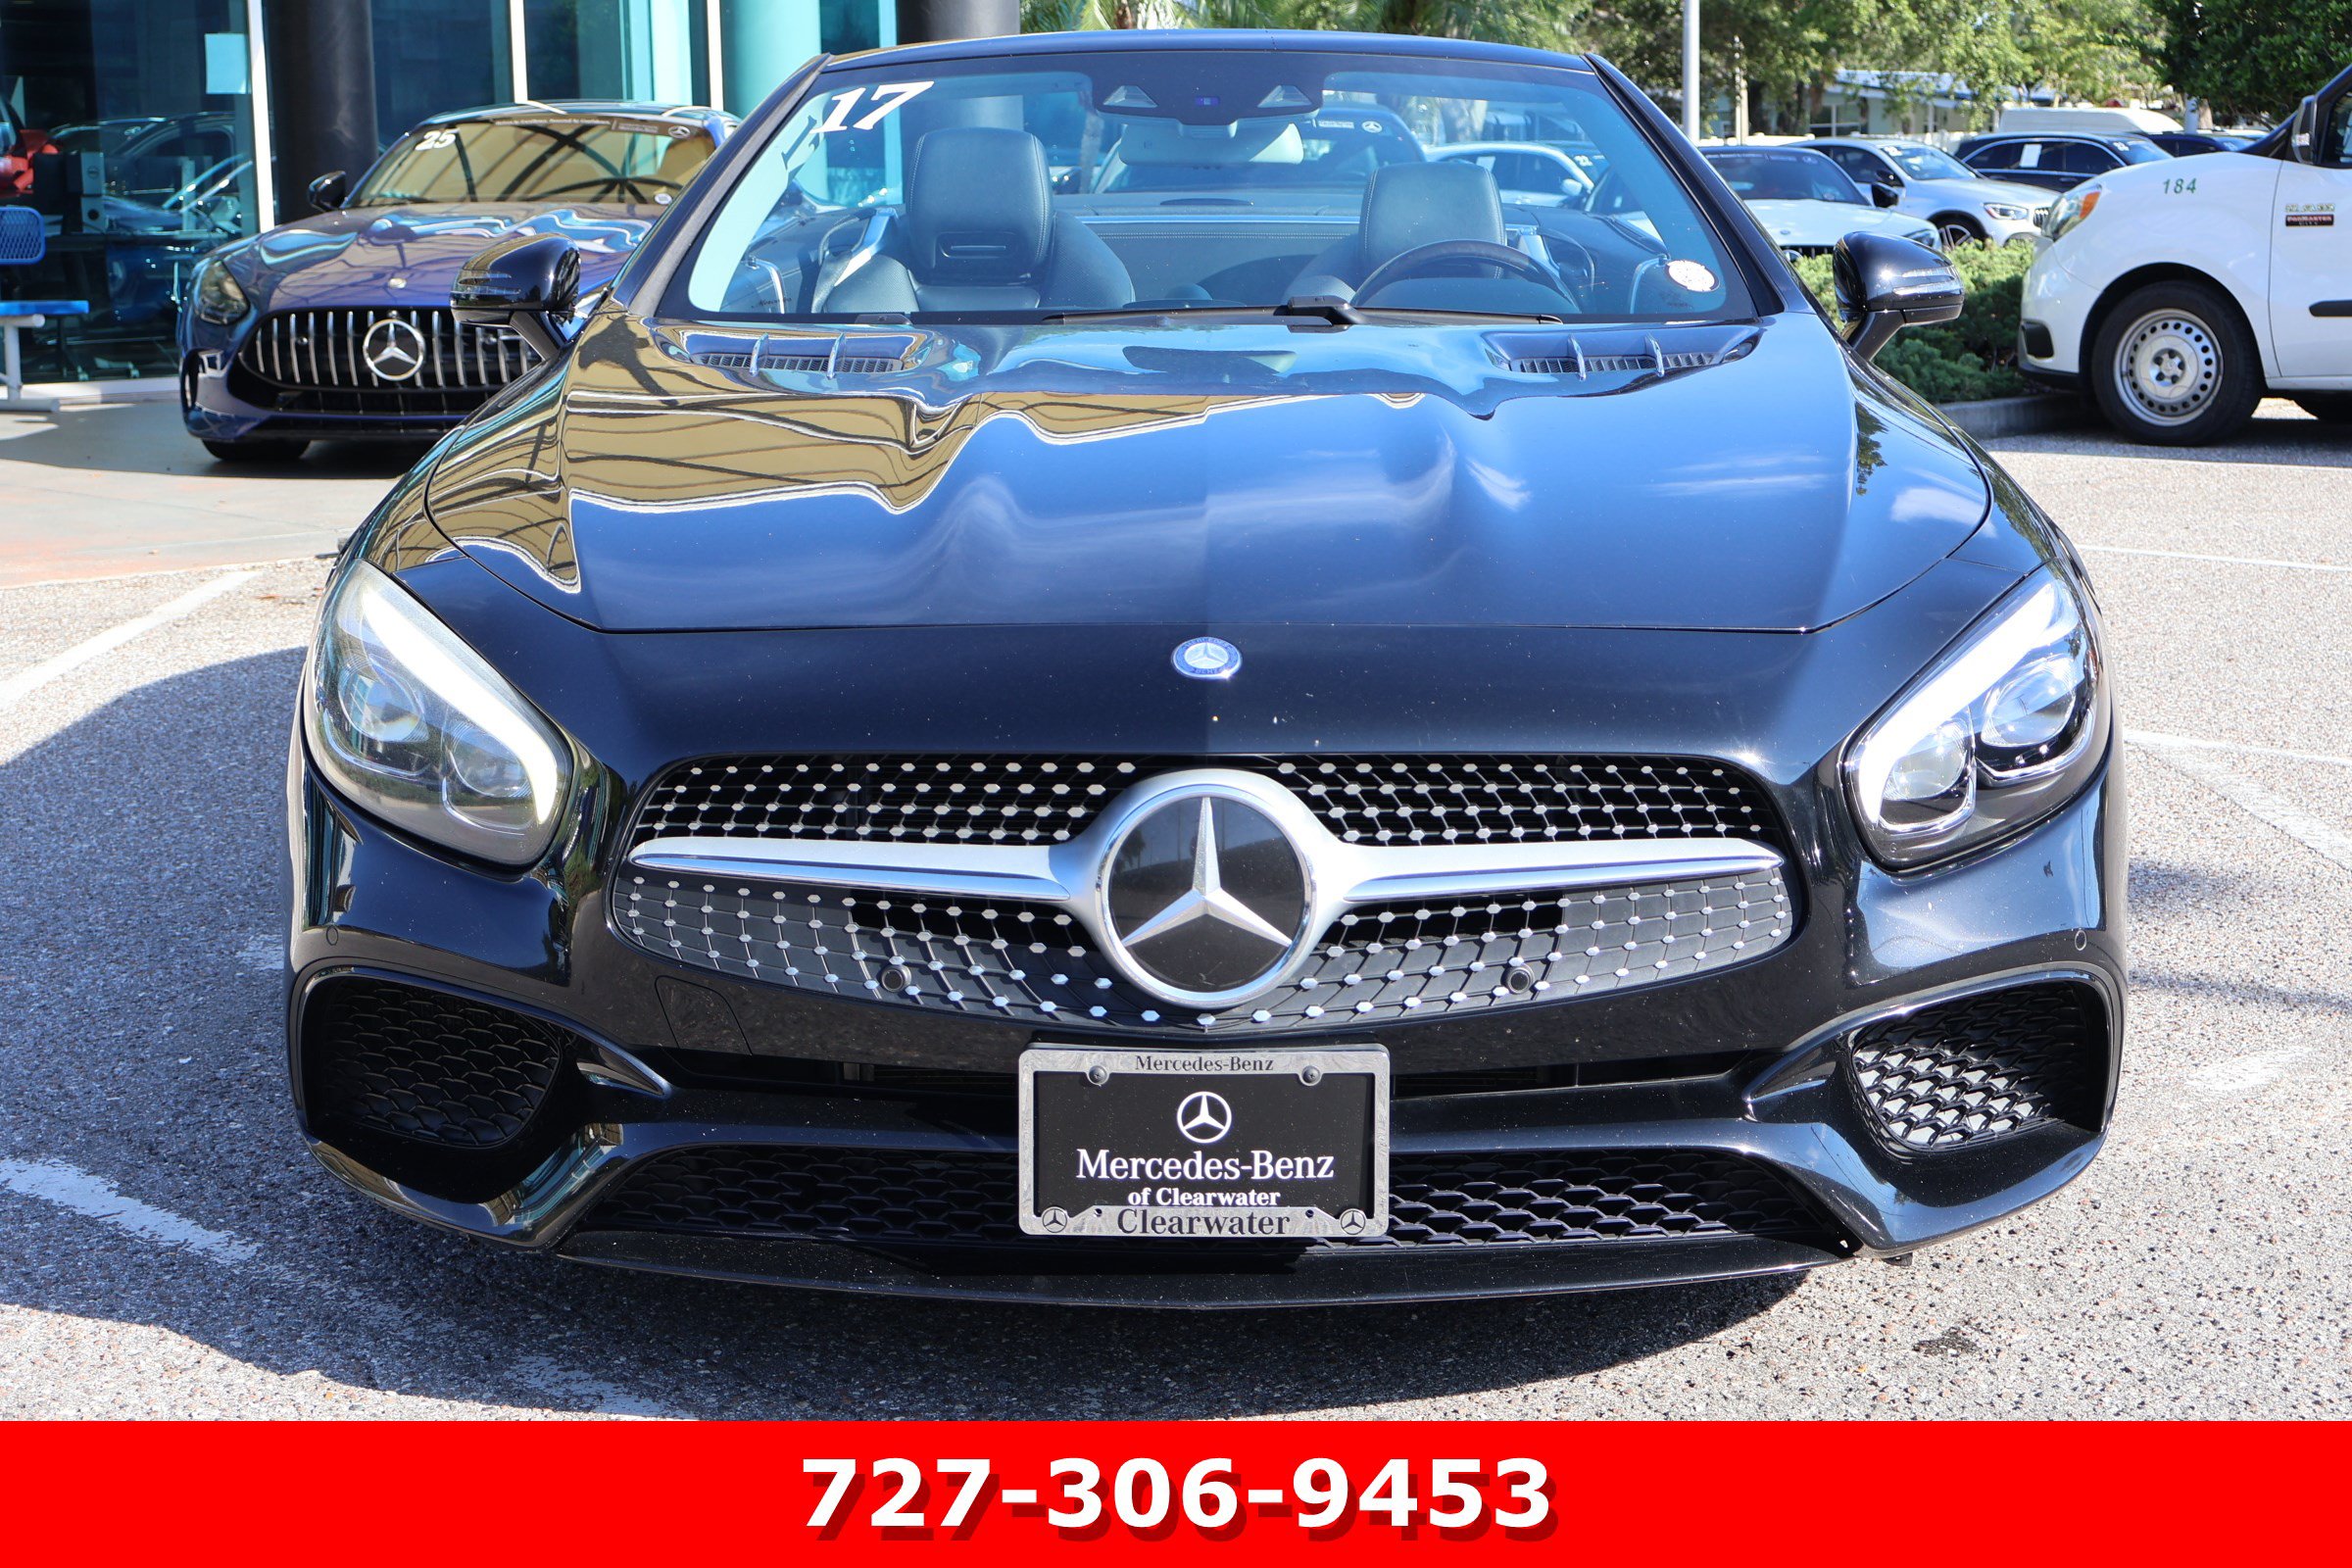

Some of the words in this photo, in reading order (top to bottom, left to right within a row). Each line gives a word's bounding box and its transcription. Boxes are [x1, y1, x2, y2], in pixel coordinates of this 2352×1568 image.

[809, 81, 934, 133] 17
[415, 128, 459, 151] 25
[2163, 177, 2197, 194] 184
[1135, 1055, 1275, 1072] Mercedes-Benz
[1076, 1149, 1334, 1180] Mercedes-Benz
[1128, 1187, 1151, 1206] of
[1155, 1187, 1281, 1206] Clearwater
[1117, 1208, 1291, 1235] Clearwater
